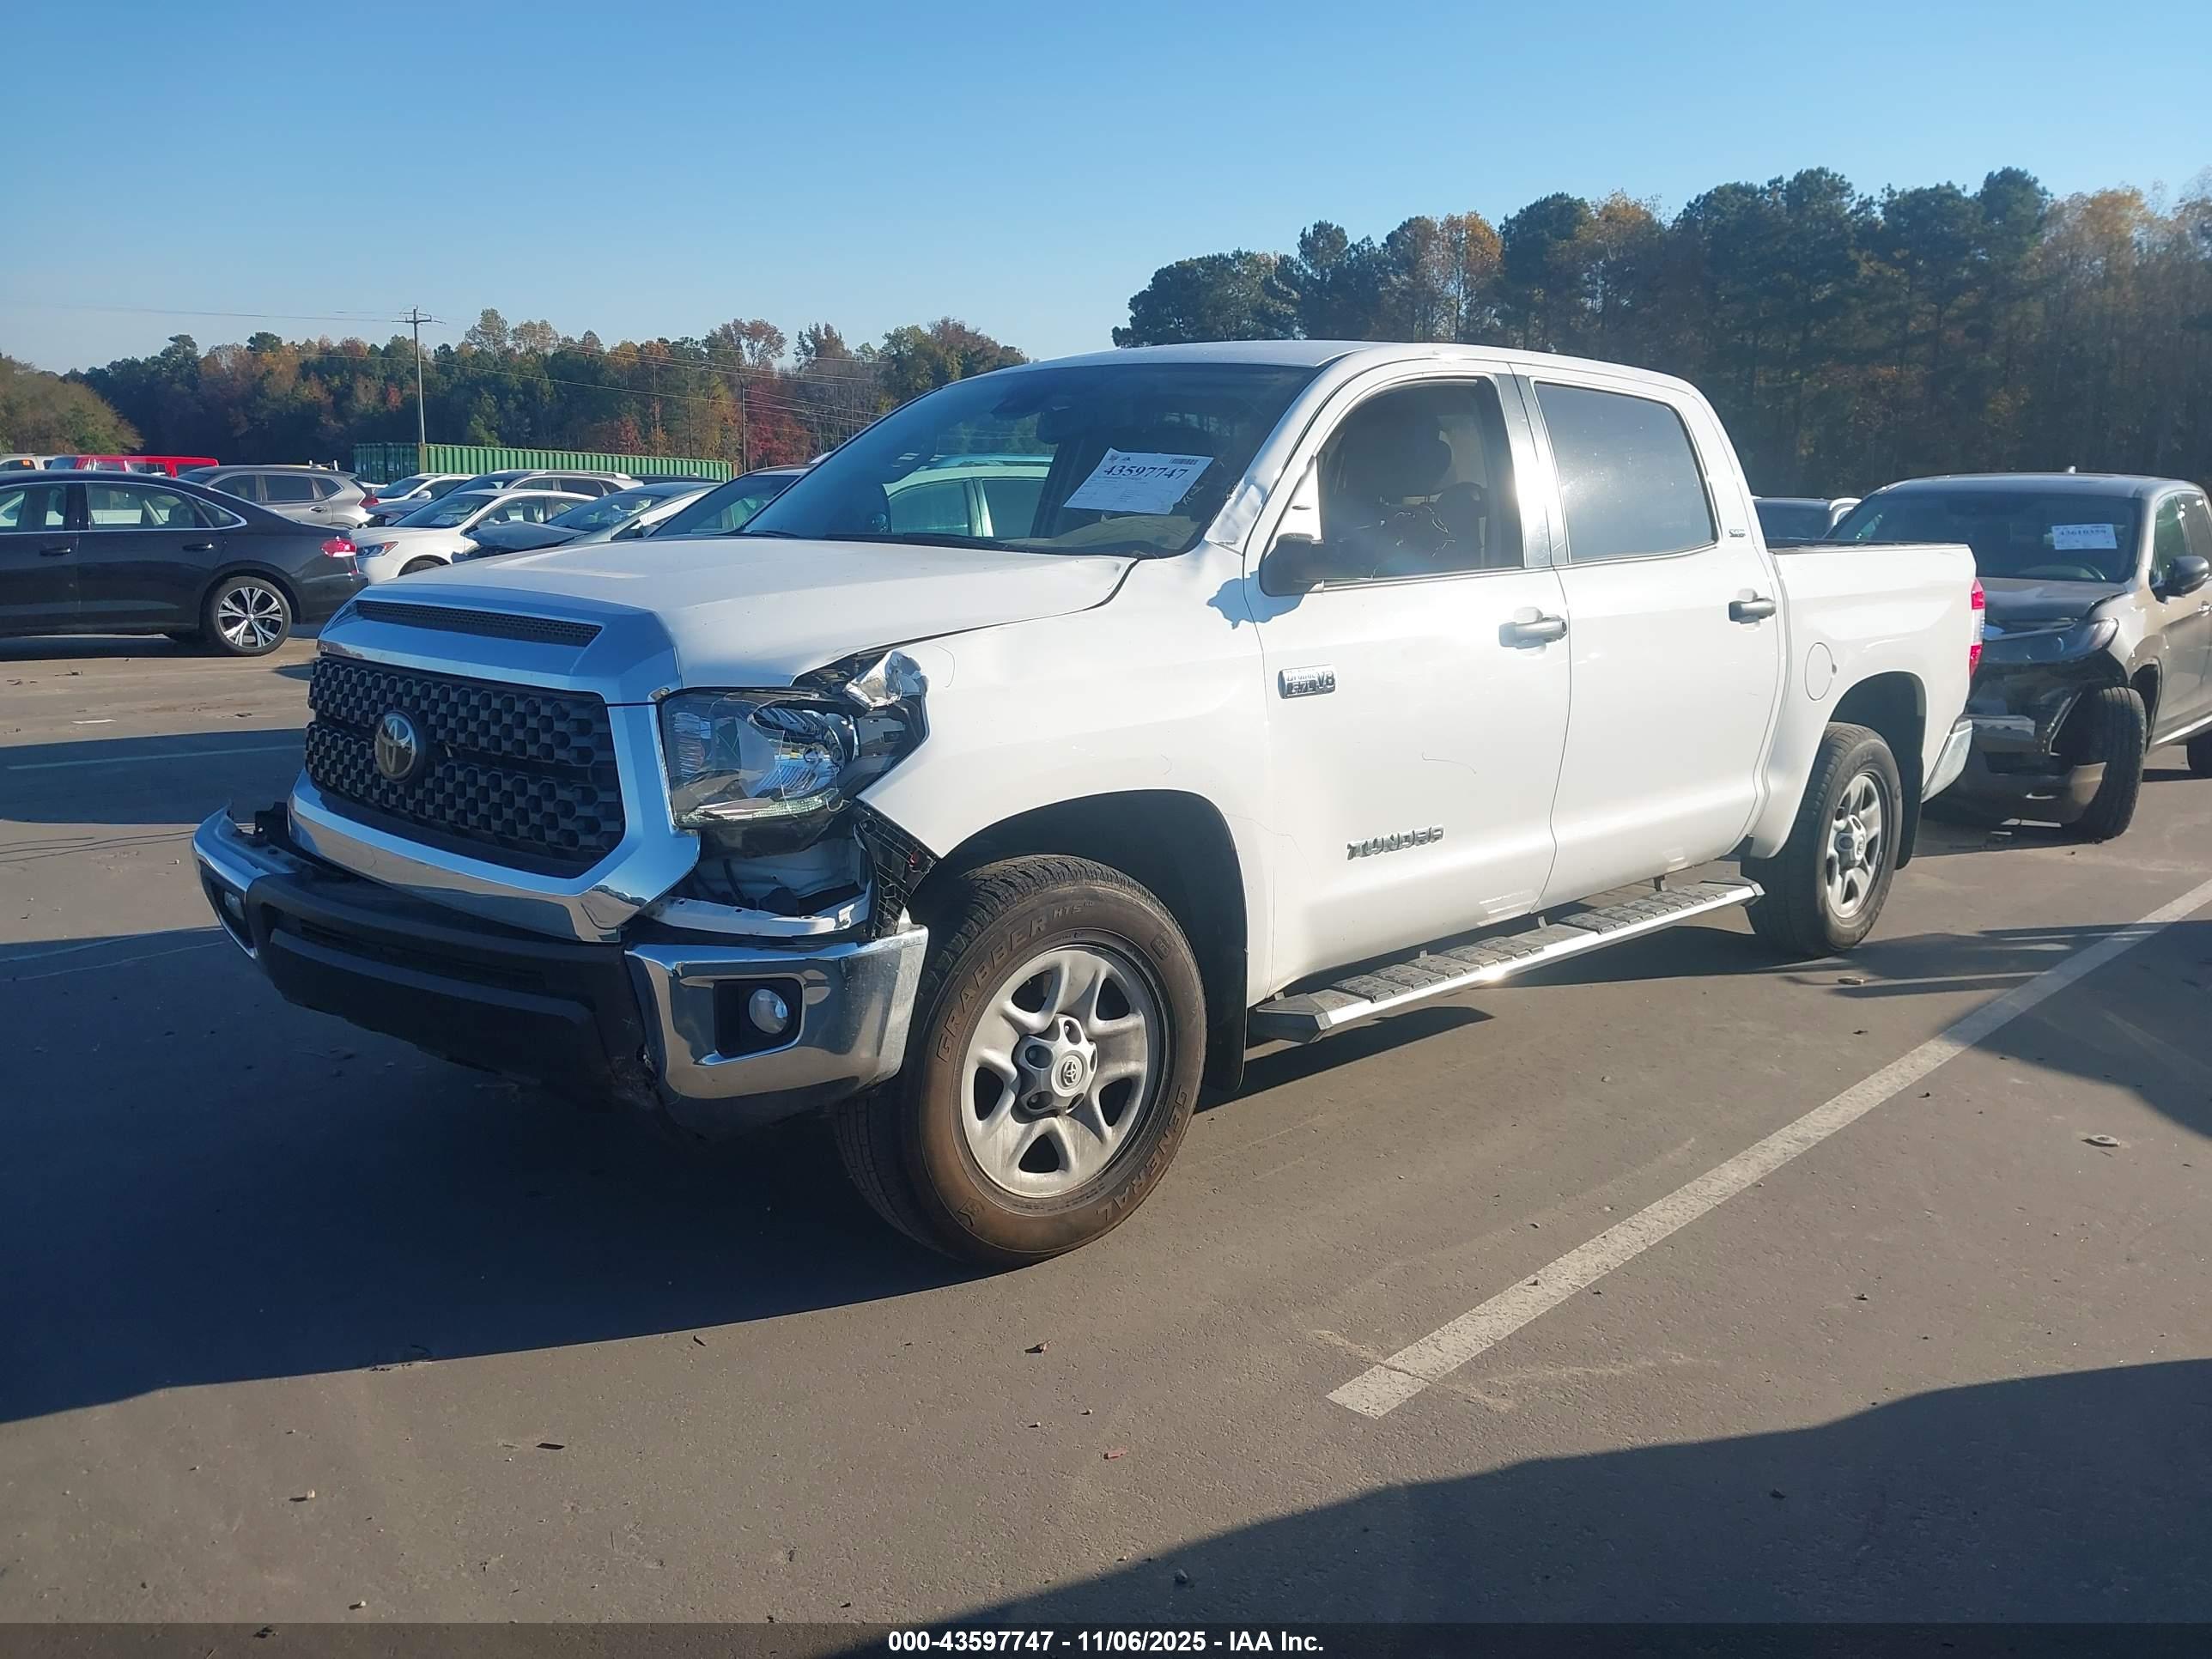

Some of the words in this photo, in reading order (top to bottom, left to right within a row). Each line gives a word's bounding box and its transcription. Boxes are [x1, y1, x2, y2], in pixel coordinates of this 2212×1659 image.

[1103, 465, 1189, 480] 43597747
[1317, 670, 1336, 690] V8
[1346, 825, 1444, 860] TUNDRA
[936, 918, 1048, 1065] GRABBER
[1096, 1085, 1188, 1222] GENERAL
